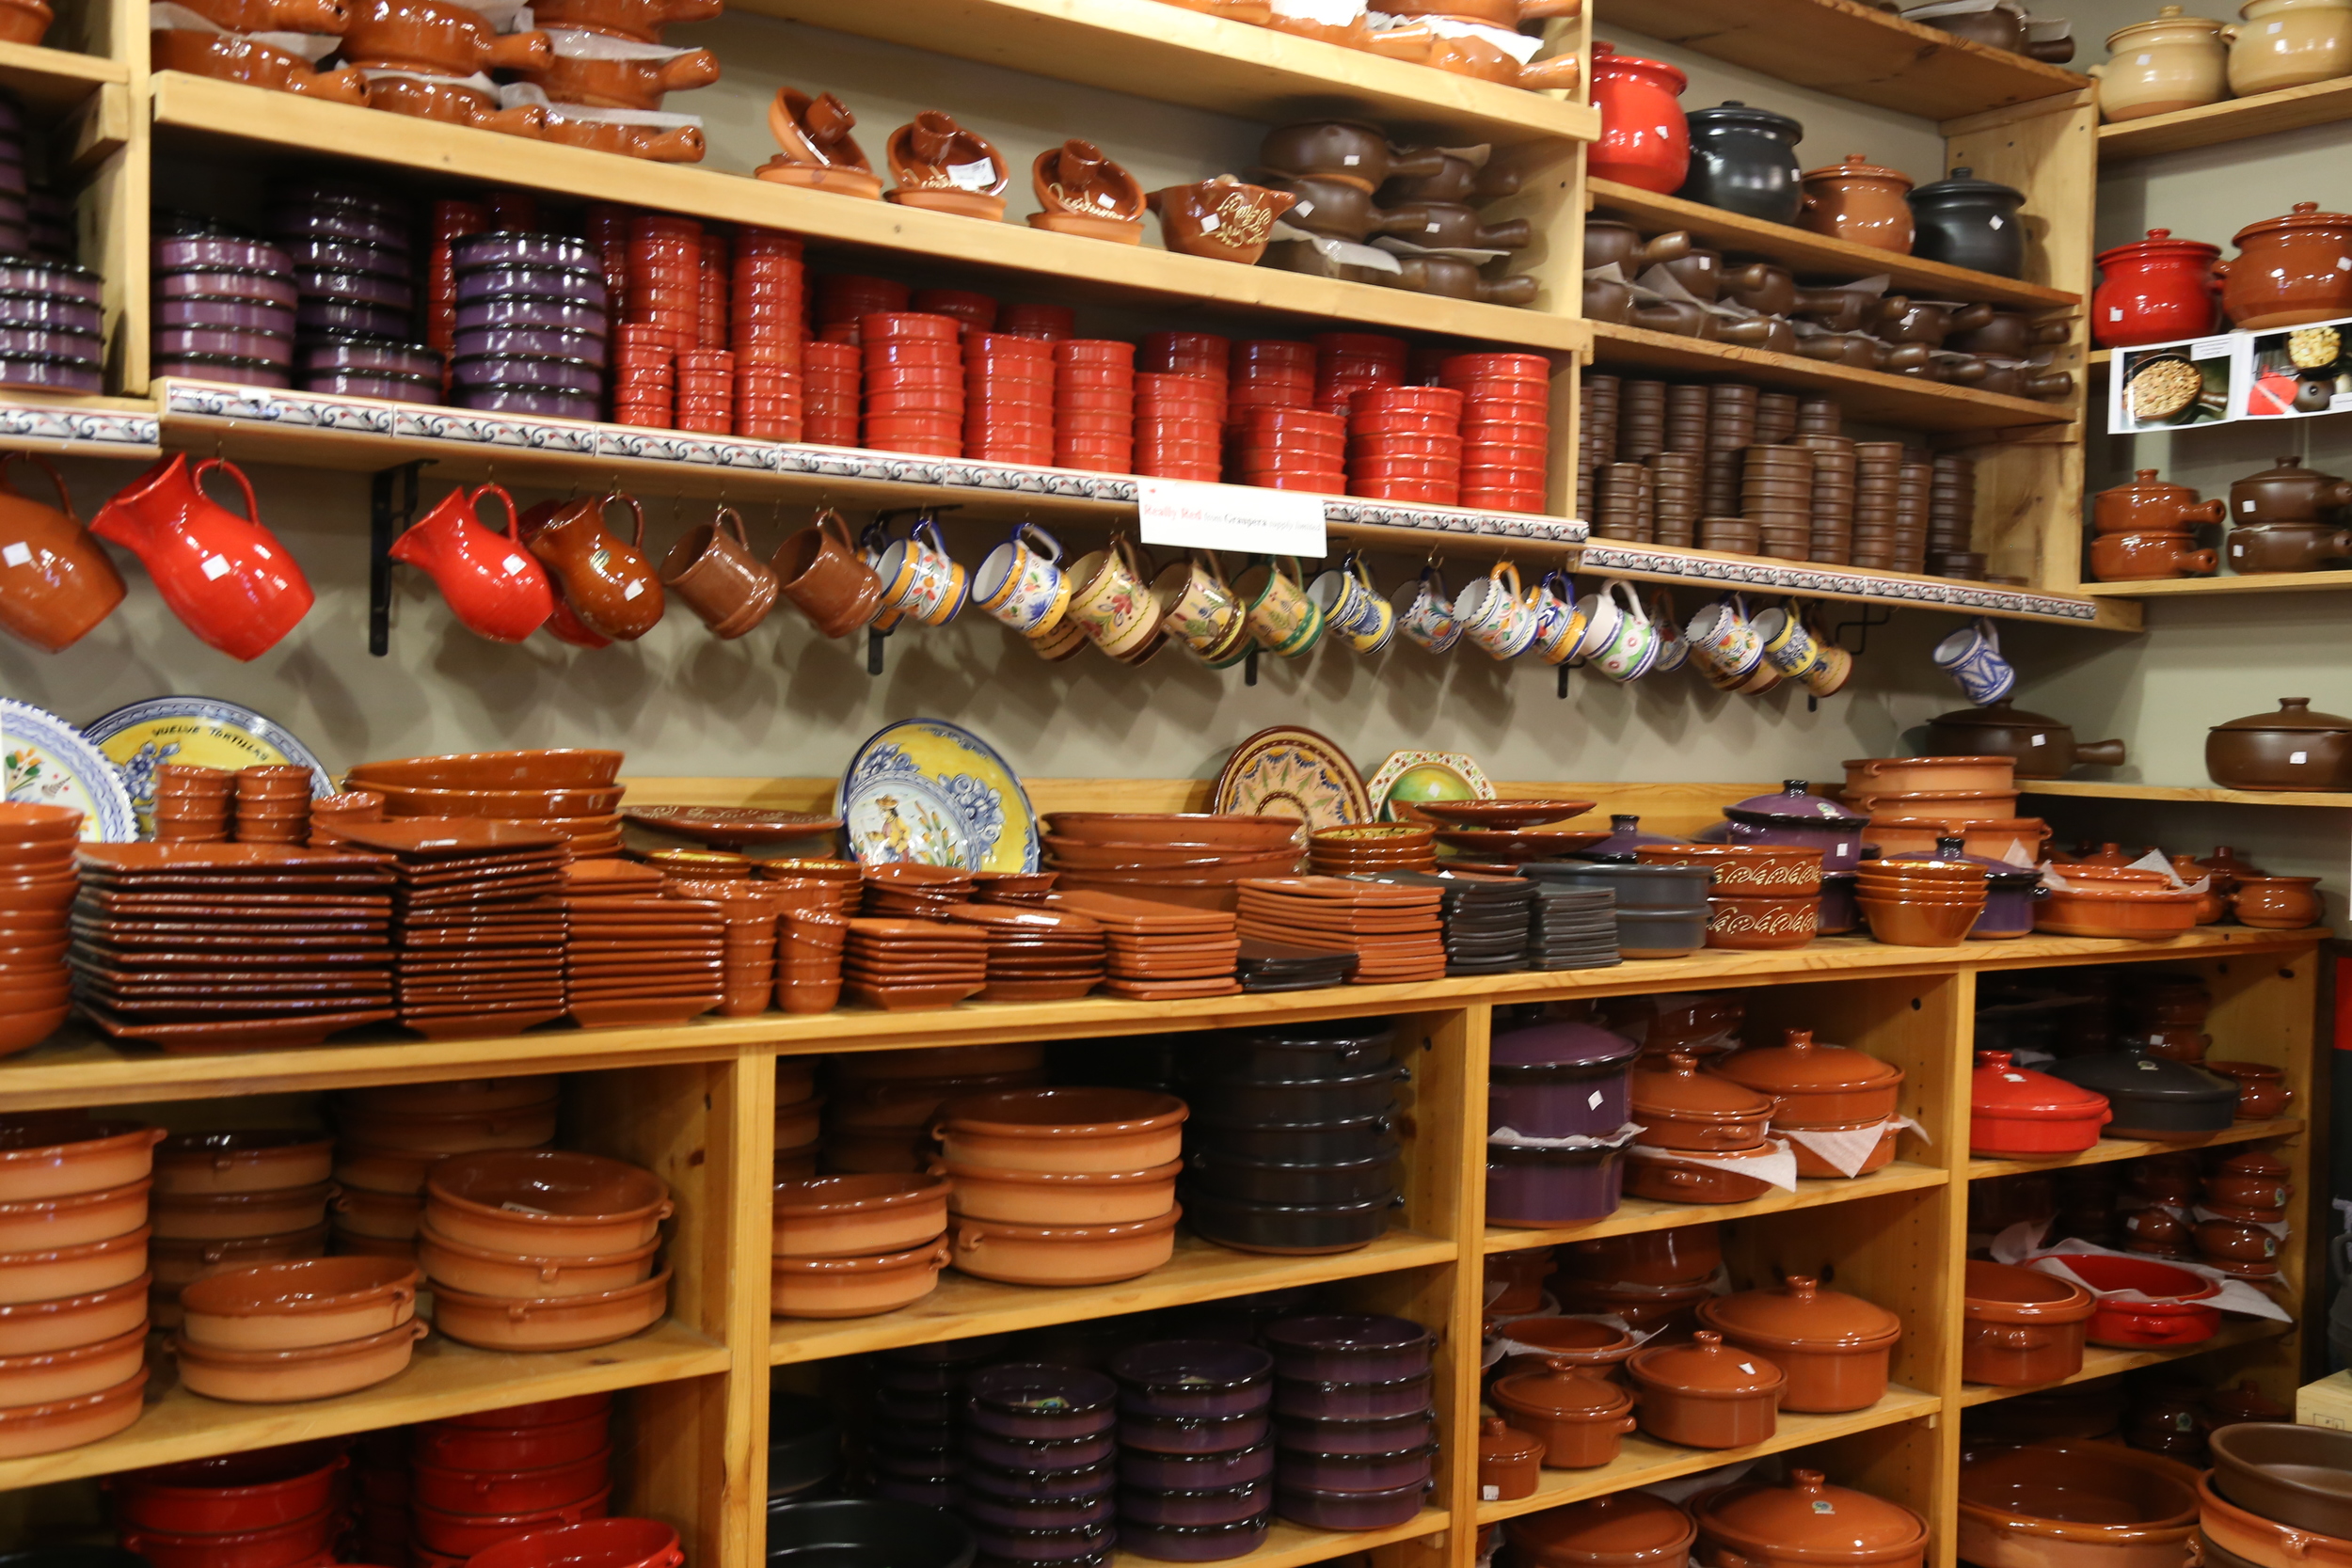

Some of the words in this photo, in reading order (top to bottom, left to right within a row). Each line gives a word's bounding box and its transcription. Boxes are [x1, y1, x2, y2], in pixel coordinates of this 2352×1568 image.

[1144, 504, 1177, 521] Really
[1181, 508, 1202, 521] Red
[1204, 512, 1223, 523] from
[152, 726, 200, 737] VUELVE
[210, 727, 270, 760] TORTILLAS
